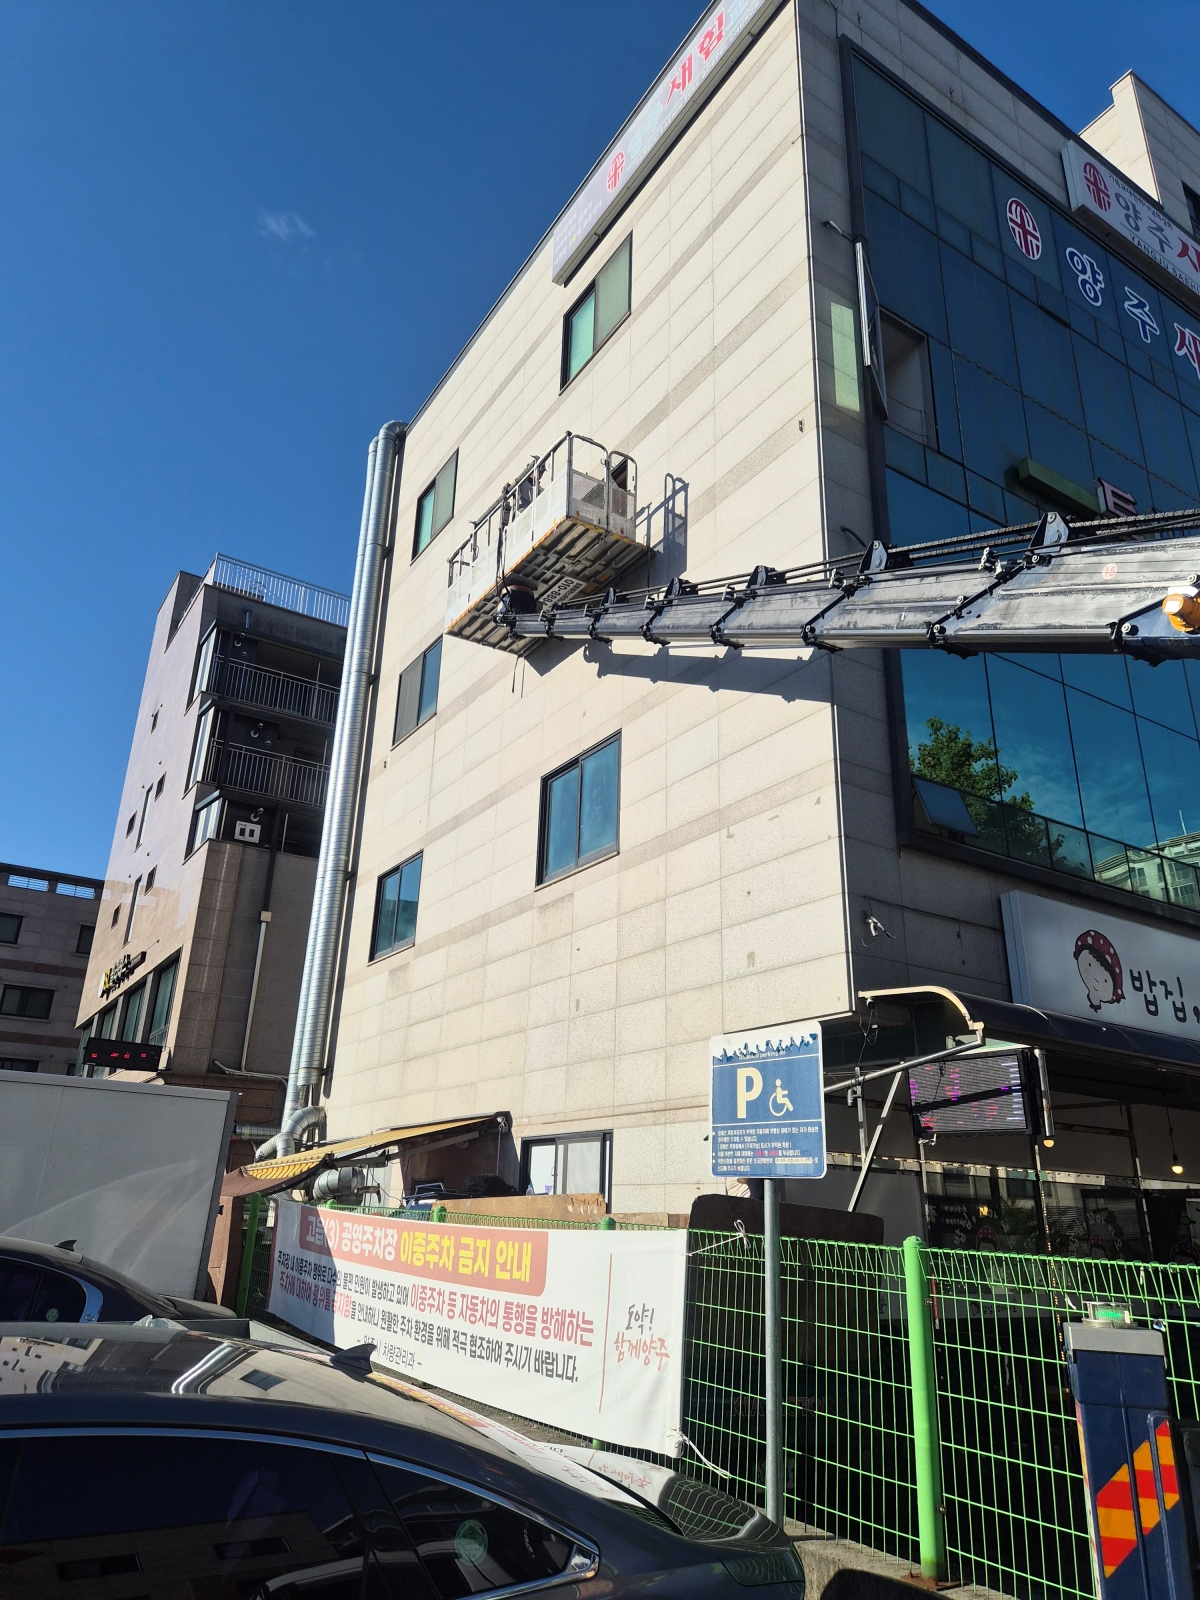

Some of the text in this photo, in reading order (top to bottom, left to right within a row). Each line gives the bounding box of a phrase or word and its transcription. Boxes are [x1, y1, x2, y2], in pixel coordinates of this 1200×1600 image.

[701, 42, 727, 79] GOSPEL
[729, 1, 759, 41] CHURCH
[1130, 234, 1169, 269] YANGJU
[736, 1067, 764, 1119] P
[305, 1215, 532, 1283] 고읍(3) 공영주차장 이중주차 금지 안내
[277, 1250, 594, 1347] 주차장 내 이중주차 행위로 다수의 불편 민원이 발생하고 있어 이중주차 등 자동차의 통행을 방해하는
[279, 1271, 579, 1383] 주차에 대하여 행위를 금지함을 안내하니 원활한 주차 환경을 위해 적극 협조하여 주시기 바랍니다.
[625, 1302, 655, 1336] 도약!
[382, 1342, 416, 1371] 차량관리과
